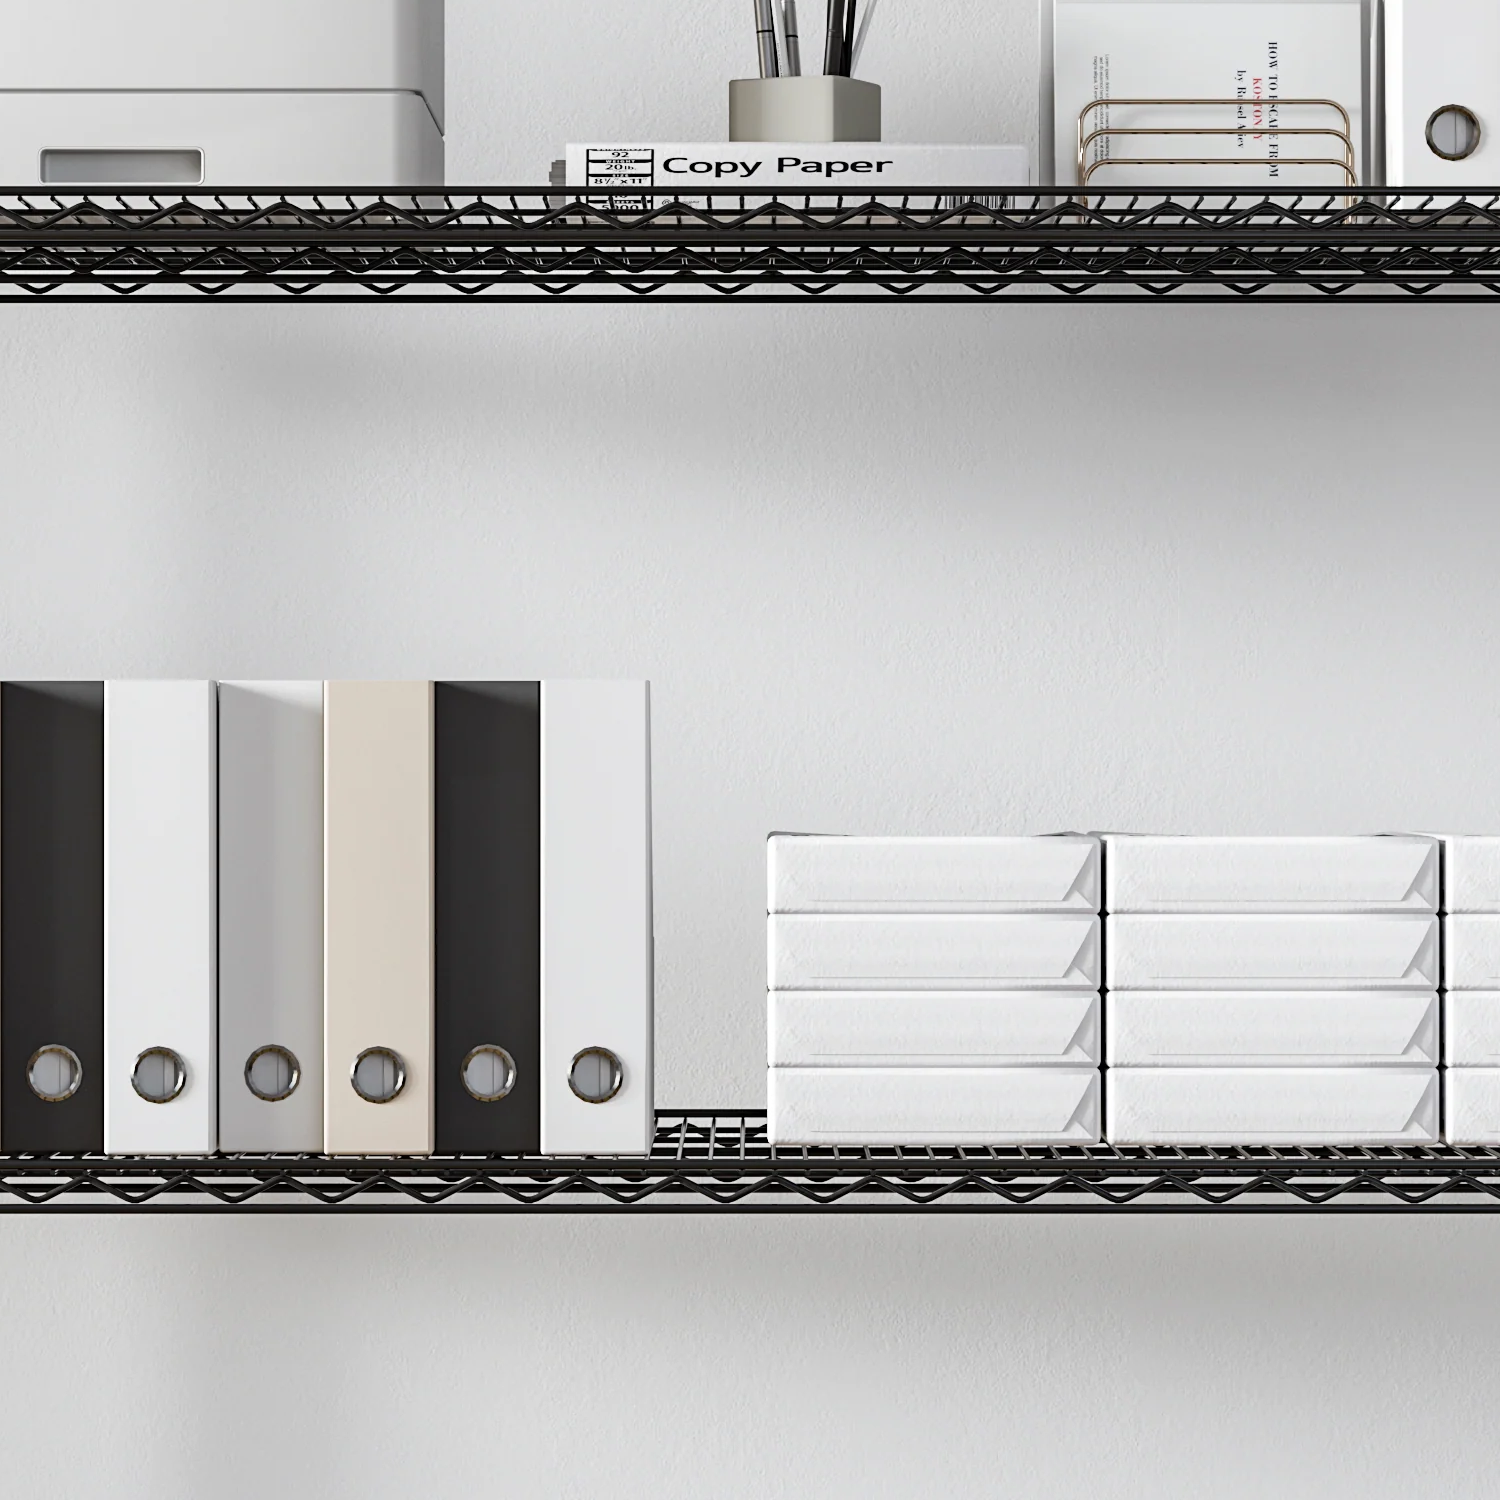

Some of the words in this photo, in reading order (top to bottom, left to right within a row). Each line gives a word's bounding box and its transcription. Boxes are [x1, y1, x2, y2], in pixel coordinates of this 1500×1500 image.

[1267, 41, 1279, 70] HOW
[1267, 74, 1279, 91] TO
[1236, 86, 1247, 119] Rusel
[1252, 77, 1263, 140] KOSTONY
[1237, 122, 1247, 148] Aiev
[610, 150, 631, 159] 92
[662, 157, 763, 179] Copy
[777, 156, 894, 178] Paper
